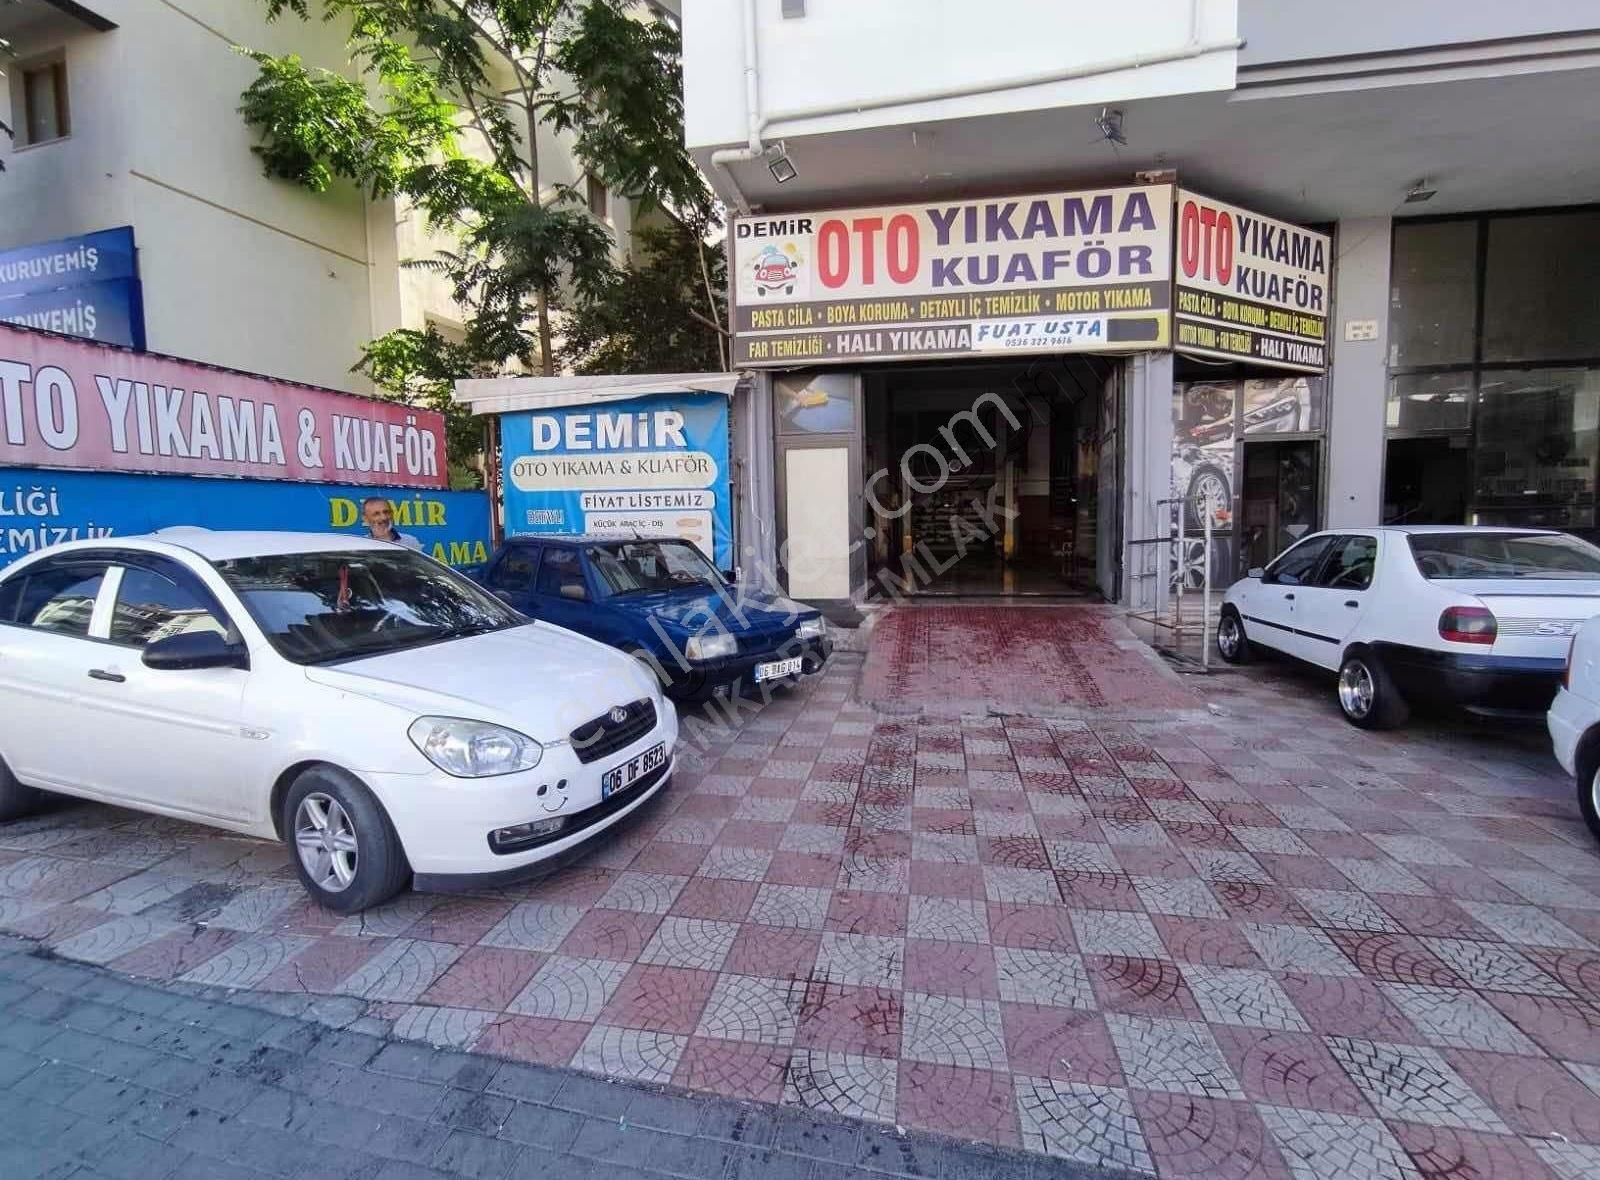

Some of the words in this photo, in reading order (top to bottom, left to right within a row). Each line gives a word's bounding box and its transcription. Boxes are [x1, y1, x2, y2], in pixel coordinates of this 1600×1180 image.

[926, 192, 1156, 246] YIKAMA
[817, 213, 920, 289] OTO
[931, 240, 1153, 288] KUAFÖR
[1181, 200, 1233, 286] OTO
[1236, 214, 1325, 274] YIKAMA
[751, 310, 785, 327] PASTA
[787, 306, 813, 325] CİLA
[827, 305, 856, 323] BOYA
[858, 303, 908, 322] KORUMA
[920, 299, 967, 319] DETAYLI
[984, 291, 1040, 314] TEMİZLİK
[1056, 291, 1099, 311] MOTOR
[1102, 289, 1152, 309] YIKAMA
[1179, 291, 1200, 313] PASTA
[1237, 265, 1323, 311] KUAFÖR
[749, 341, 768, 358] FAR
[770, 334, 823, 356] TEMİZLİĞİ
[837, 332, 882, 354] HALI
[886, 327, 971, 352] YIKAMA
[977, 323, 1037, 342] FUAT
[1043, 319, 1102, 337] USTA
[1260, 338, 1284, 359] HALI
[1286, 342, 1324, 365] YIKAMA
[95, 375, 286, 466] YIKAMA
[298, 408, 323, 469] &
[331, 414, 438, 477] KUAFÖR
[513, 462, 547, 478] OTO
[552, 459, 615, 477] YIKAMA
[620, 460, 632, 476] &
[637, 455, 709, 475] KUAFÖR
[329, 494, 447, 527] DMİR
[584, 494, 624, 508] FİYAT
[610, 769, 622, 793] 06
[628, 759, 639, 781] DF
[643, 746, 664, 773] 8523
